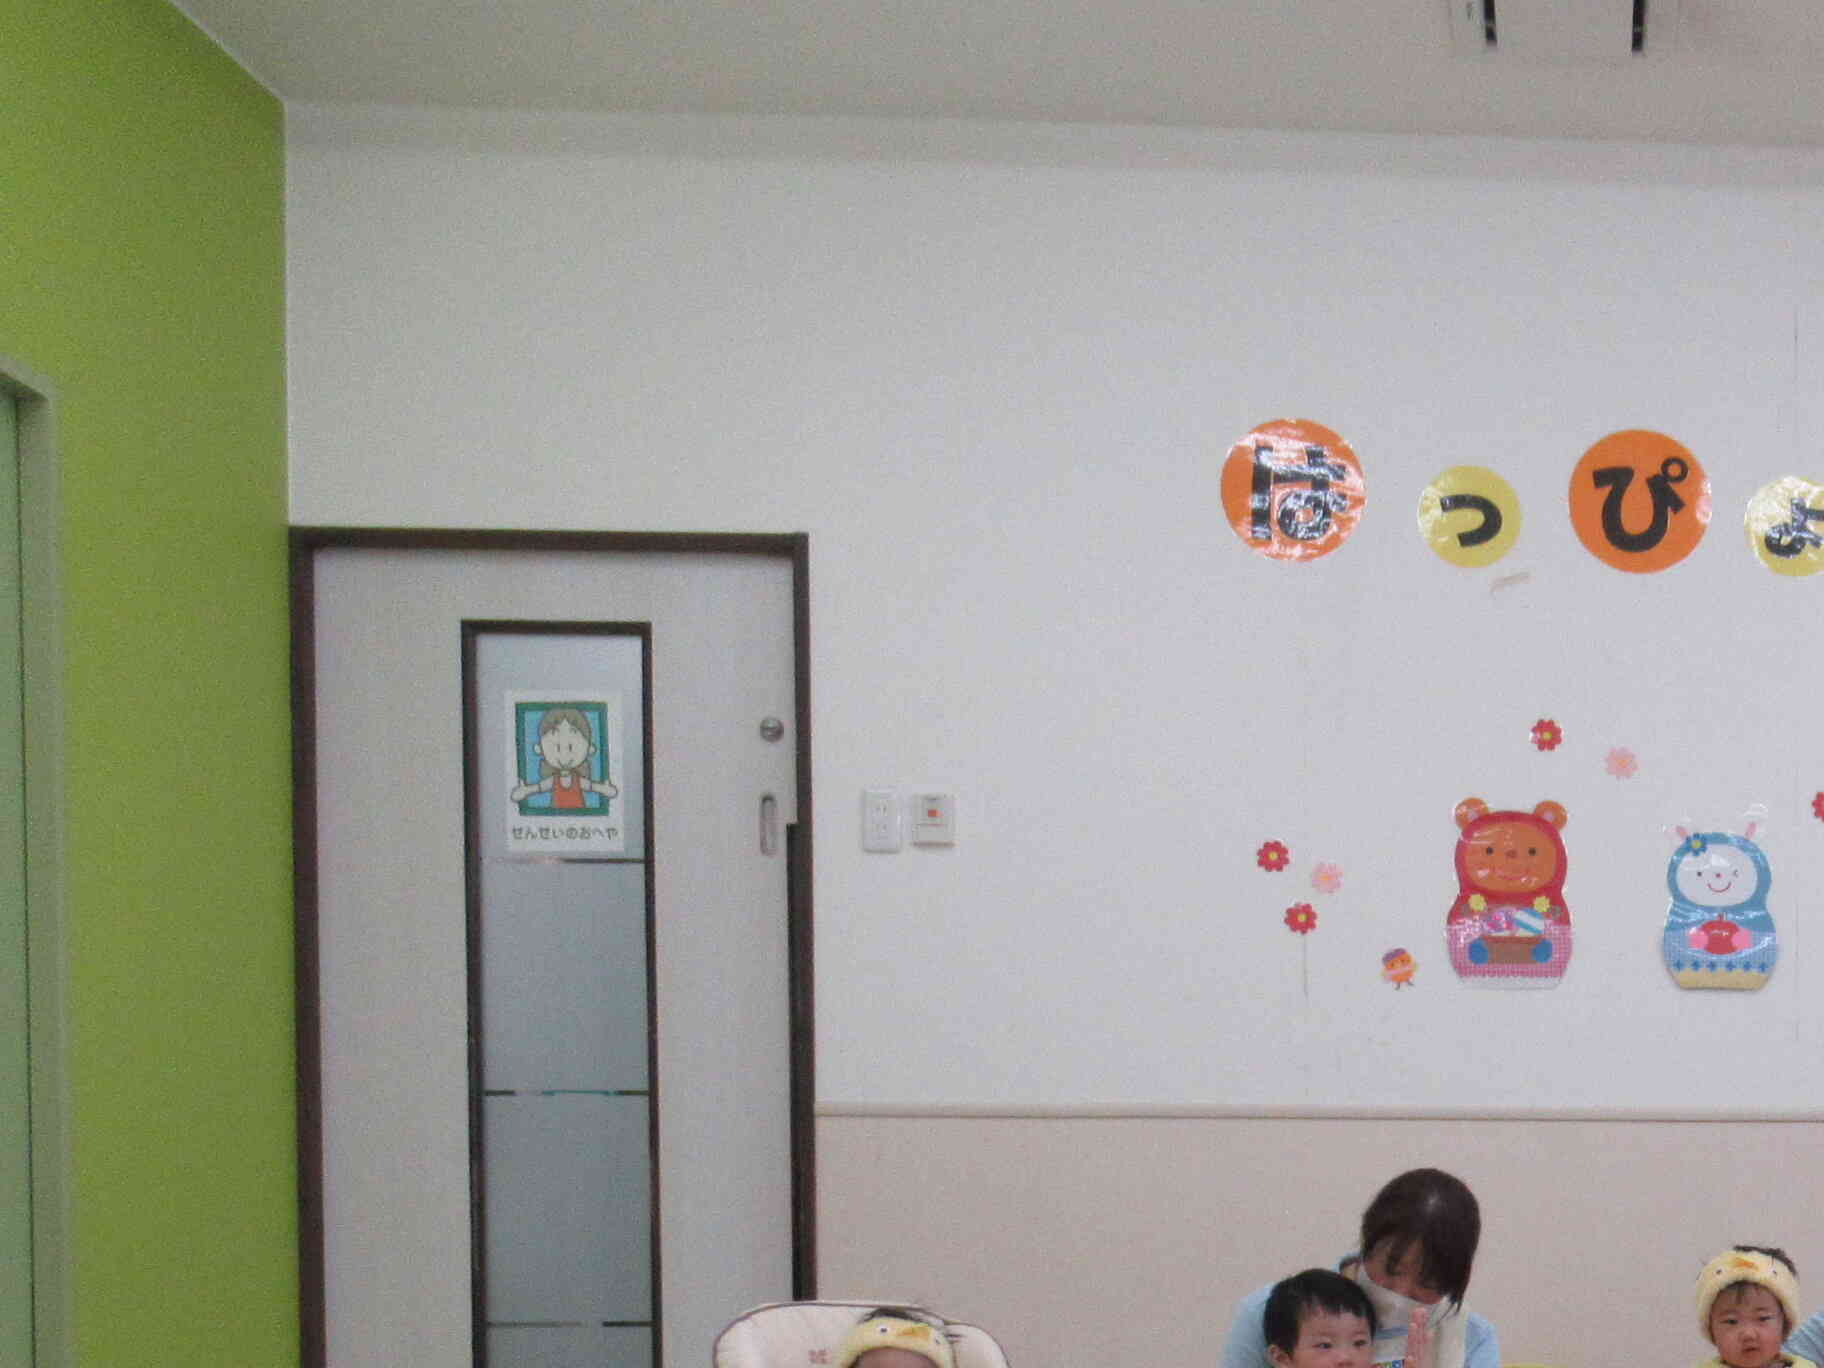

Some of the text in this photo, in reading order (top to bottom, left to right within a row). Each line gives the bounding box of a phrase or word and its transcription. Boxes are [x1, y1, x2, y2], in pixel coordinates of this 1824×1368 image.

[512, 826, 618, 840] せんせいのおへや
